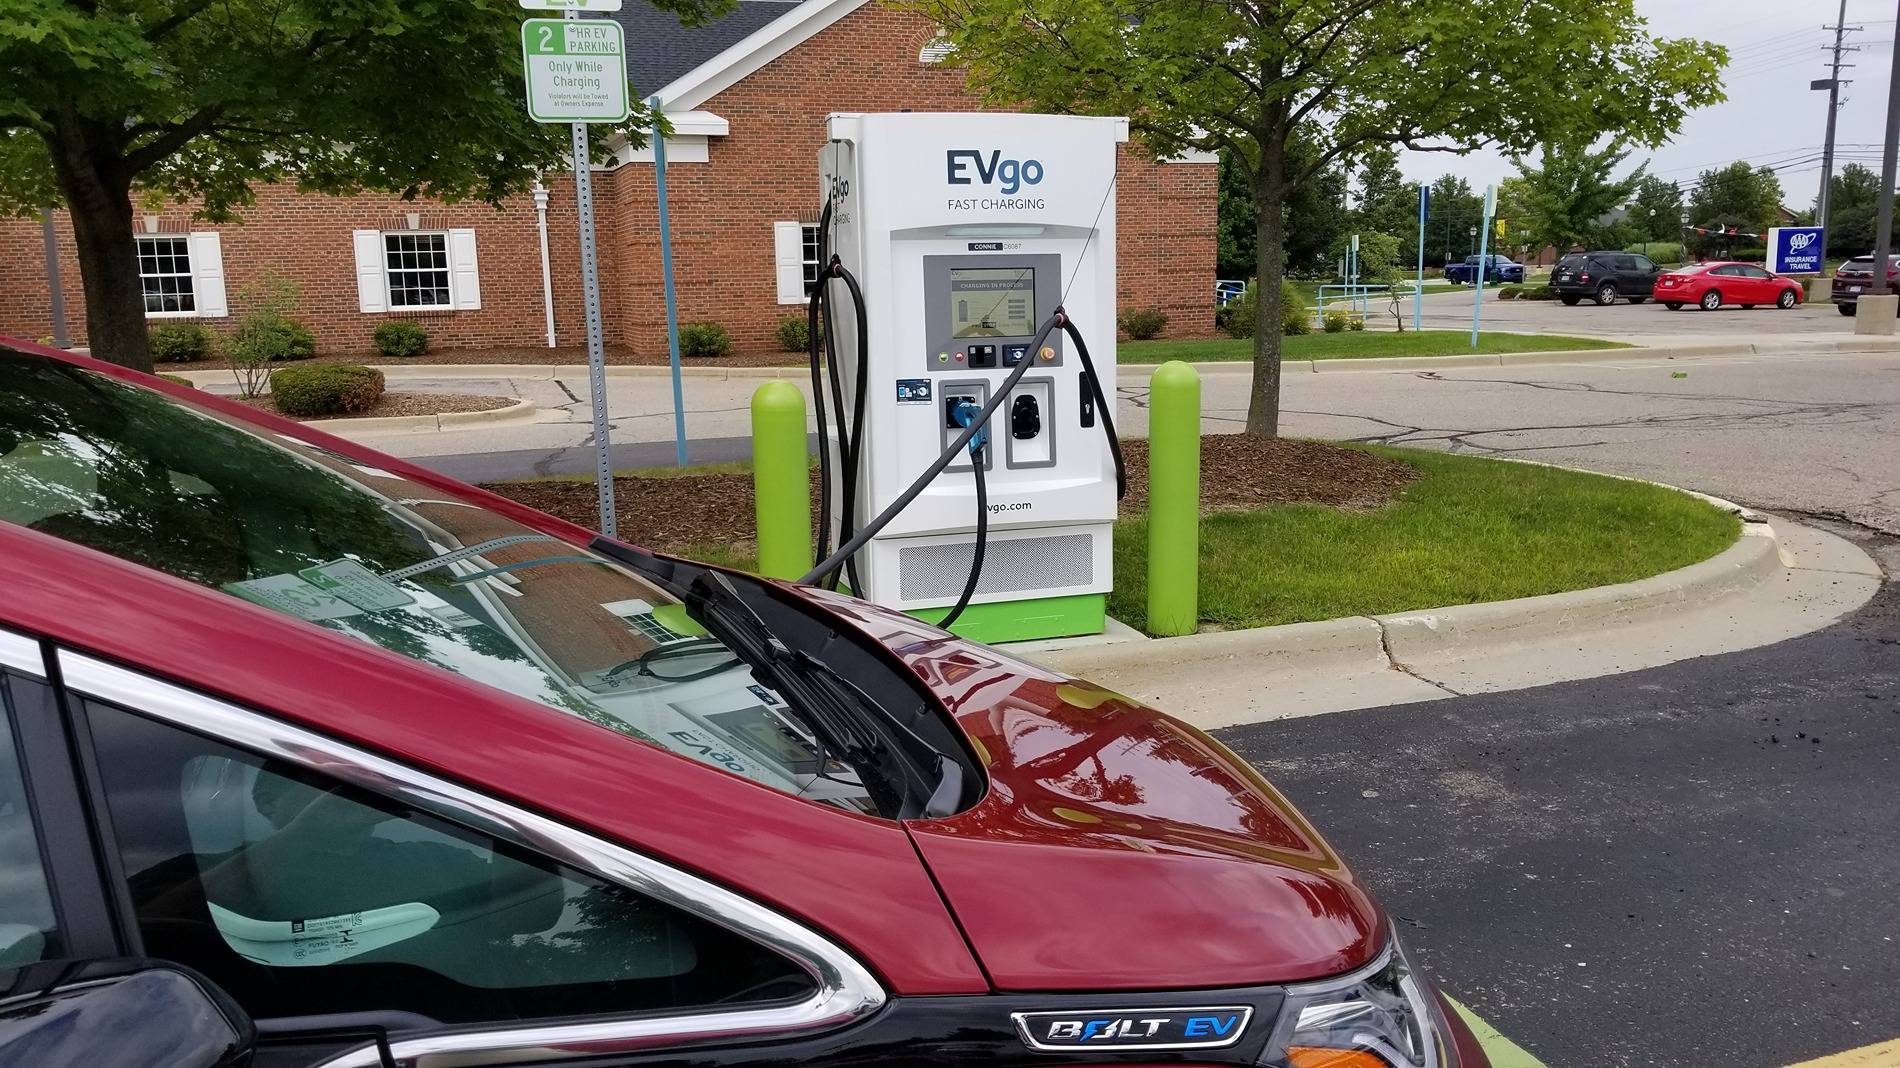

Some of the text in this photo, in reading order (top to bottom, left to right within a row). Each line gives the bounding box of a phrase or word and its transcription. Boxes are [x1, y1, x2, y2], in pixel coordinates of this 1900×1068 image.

[538, 26, 554, 52] 2
[576, 28, 607, 38] HR EV
[570, 41, 616, 52] PARKING
[548, 60, 603, 73] Only While
[553, 76, 600, 90] Charging
[947, 150, 1044, 195] EVgo
[948, 198, 1045, 210] FAST CHARGING
[974, 242, 997, 250] CONNIE
[986, 502, 1032, 514] vgo.com
[1047, 1016, 1237, 1042] BOLT EV
